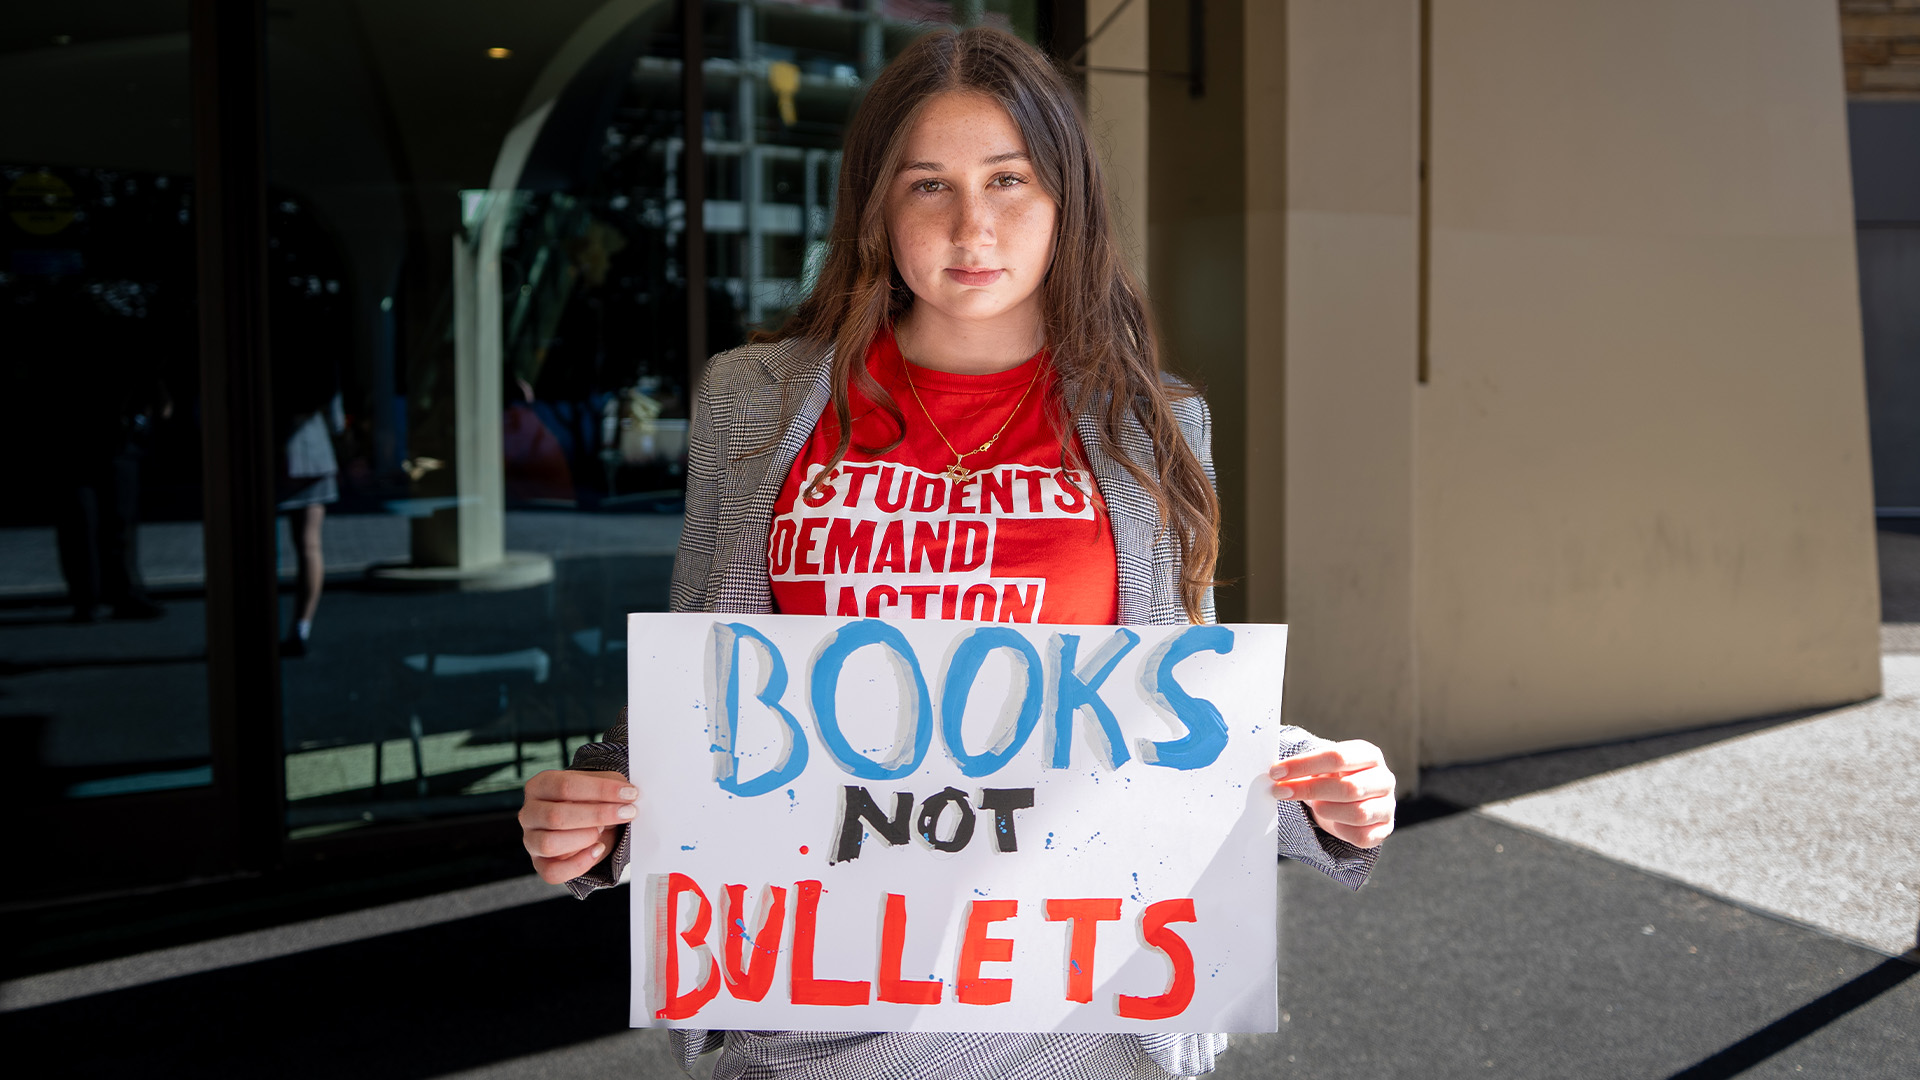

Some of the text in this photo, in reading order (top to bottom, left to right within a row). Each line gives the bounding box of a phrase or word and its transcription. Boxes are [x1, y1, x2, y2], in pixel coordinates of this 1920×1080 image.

[802, 464, 1087, 515] STUDENTS
[771, 517, 990, 576] DEMAND
[704, 619, 1235, 798] BOOKS
[828, 785, 1035, 866] NOT
[646, 872, 1198, 1021] BULLETS
